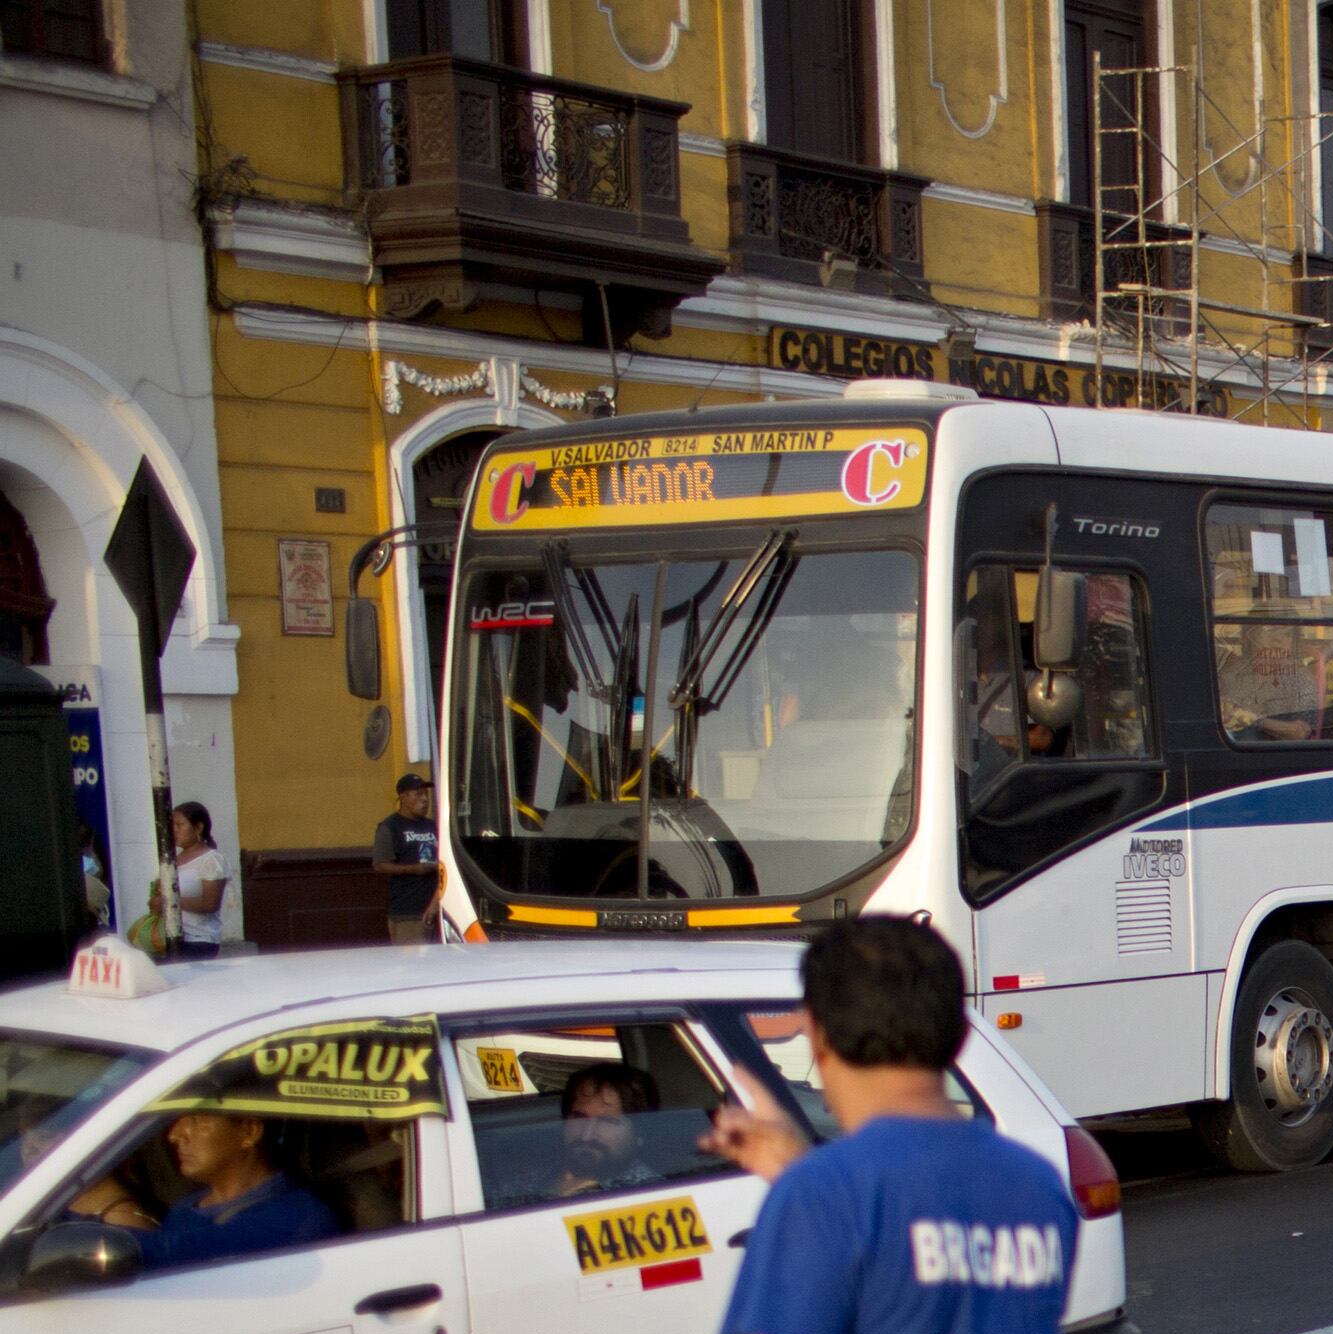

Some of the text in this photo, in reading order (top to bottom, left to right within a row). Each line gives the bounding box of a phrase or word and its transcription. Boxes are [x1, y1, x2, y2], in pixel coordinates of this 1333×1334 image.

[779, 331, 1229, 420] COLEGIOS NICOLAS COPERNO
[551, 431, 834, 468] V.SALVADOR 8214 SAN MARTIN P
[1073, 518, 1160, 538] Torino
[472, 601, 554, 622] WRC
[1123, 852, 1186, 879] IVECO
[78, 954, 121, 989] TAXI
[254, 1042, 432, 1082] OPALUX
[482, 1061, 520, 1087] 8214
[287, 1083, 400, 1100] ILUMINACION LED
[909, 1218, 1064, 1288] BRGADA
